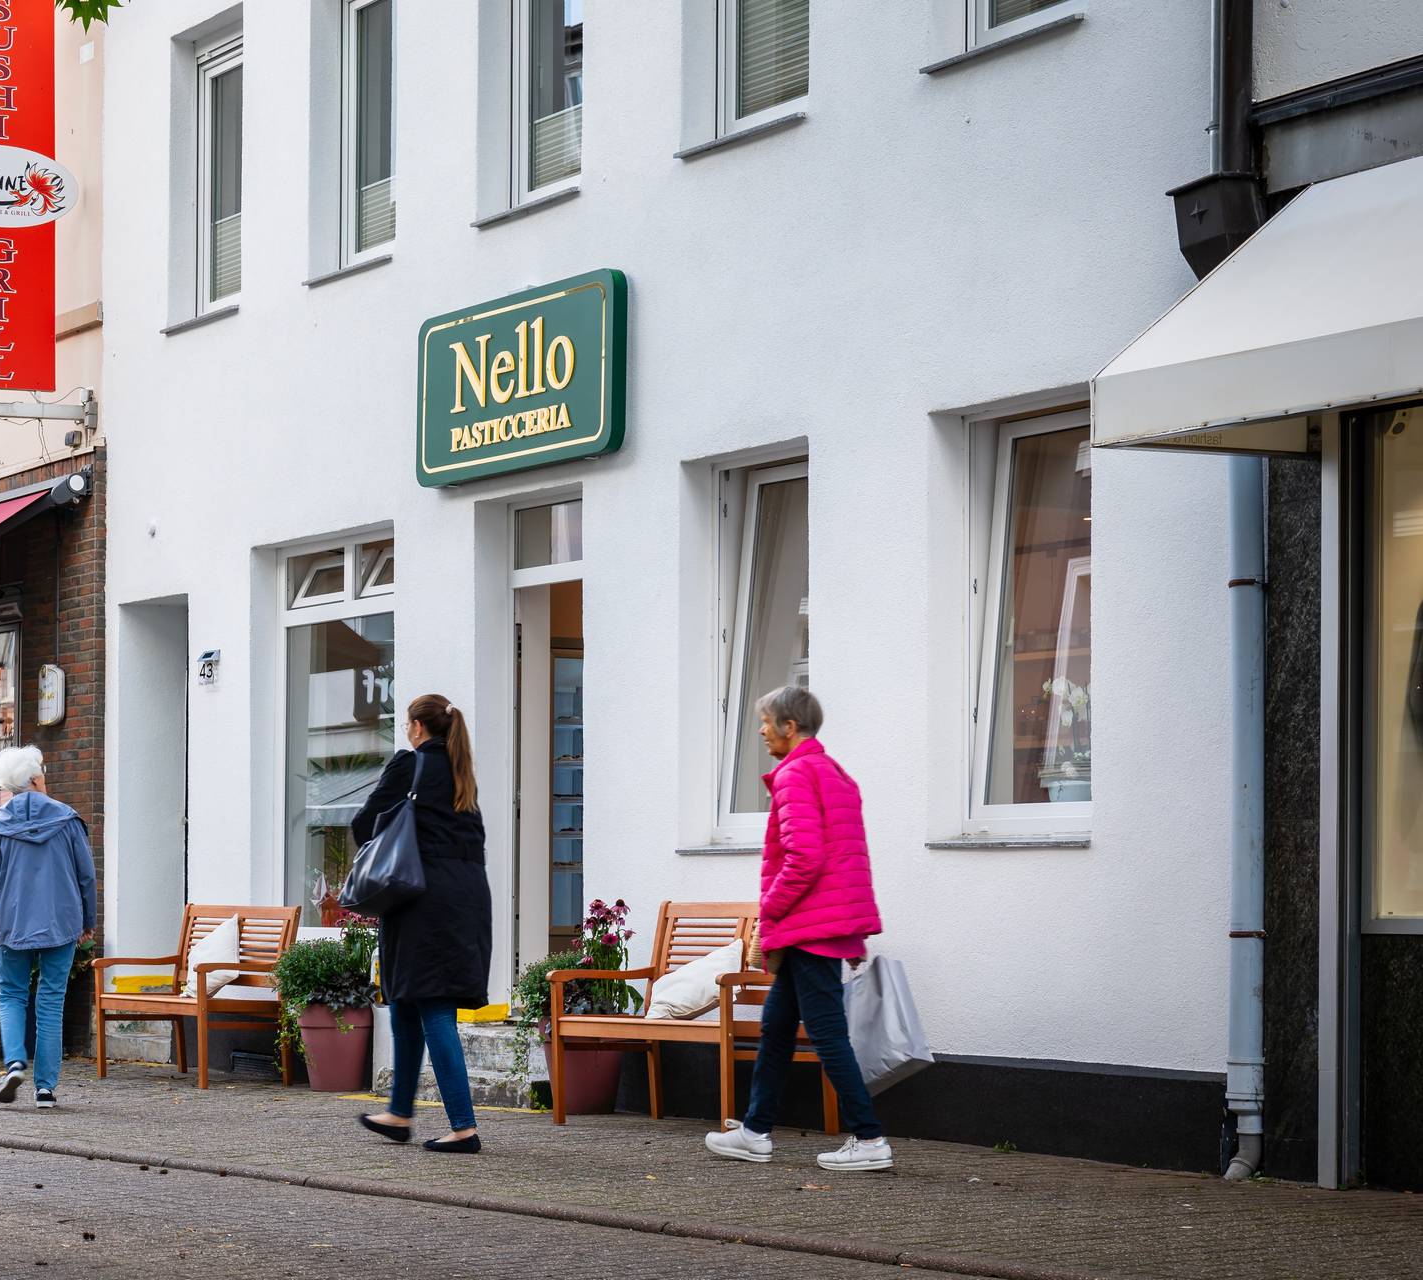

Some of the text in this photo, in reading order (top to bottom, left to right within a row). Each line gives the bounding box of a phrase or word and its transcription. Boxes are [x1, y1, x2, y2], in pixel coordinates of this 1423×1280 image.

[10, 209, 31, 217] GRILL
[449, 316, 575, 414] Nello
[449, 402, 571, 453] PASTICCERIA
[199, 662, 213, 679] 43
